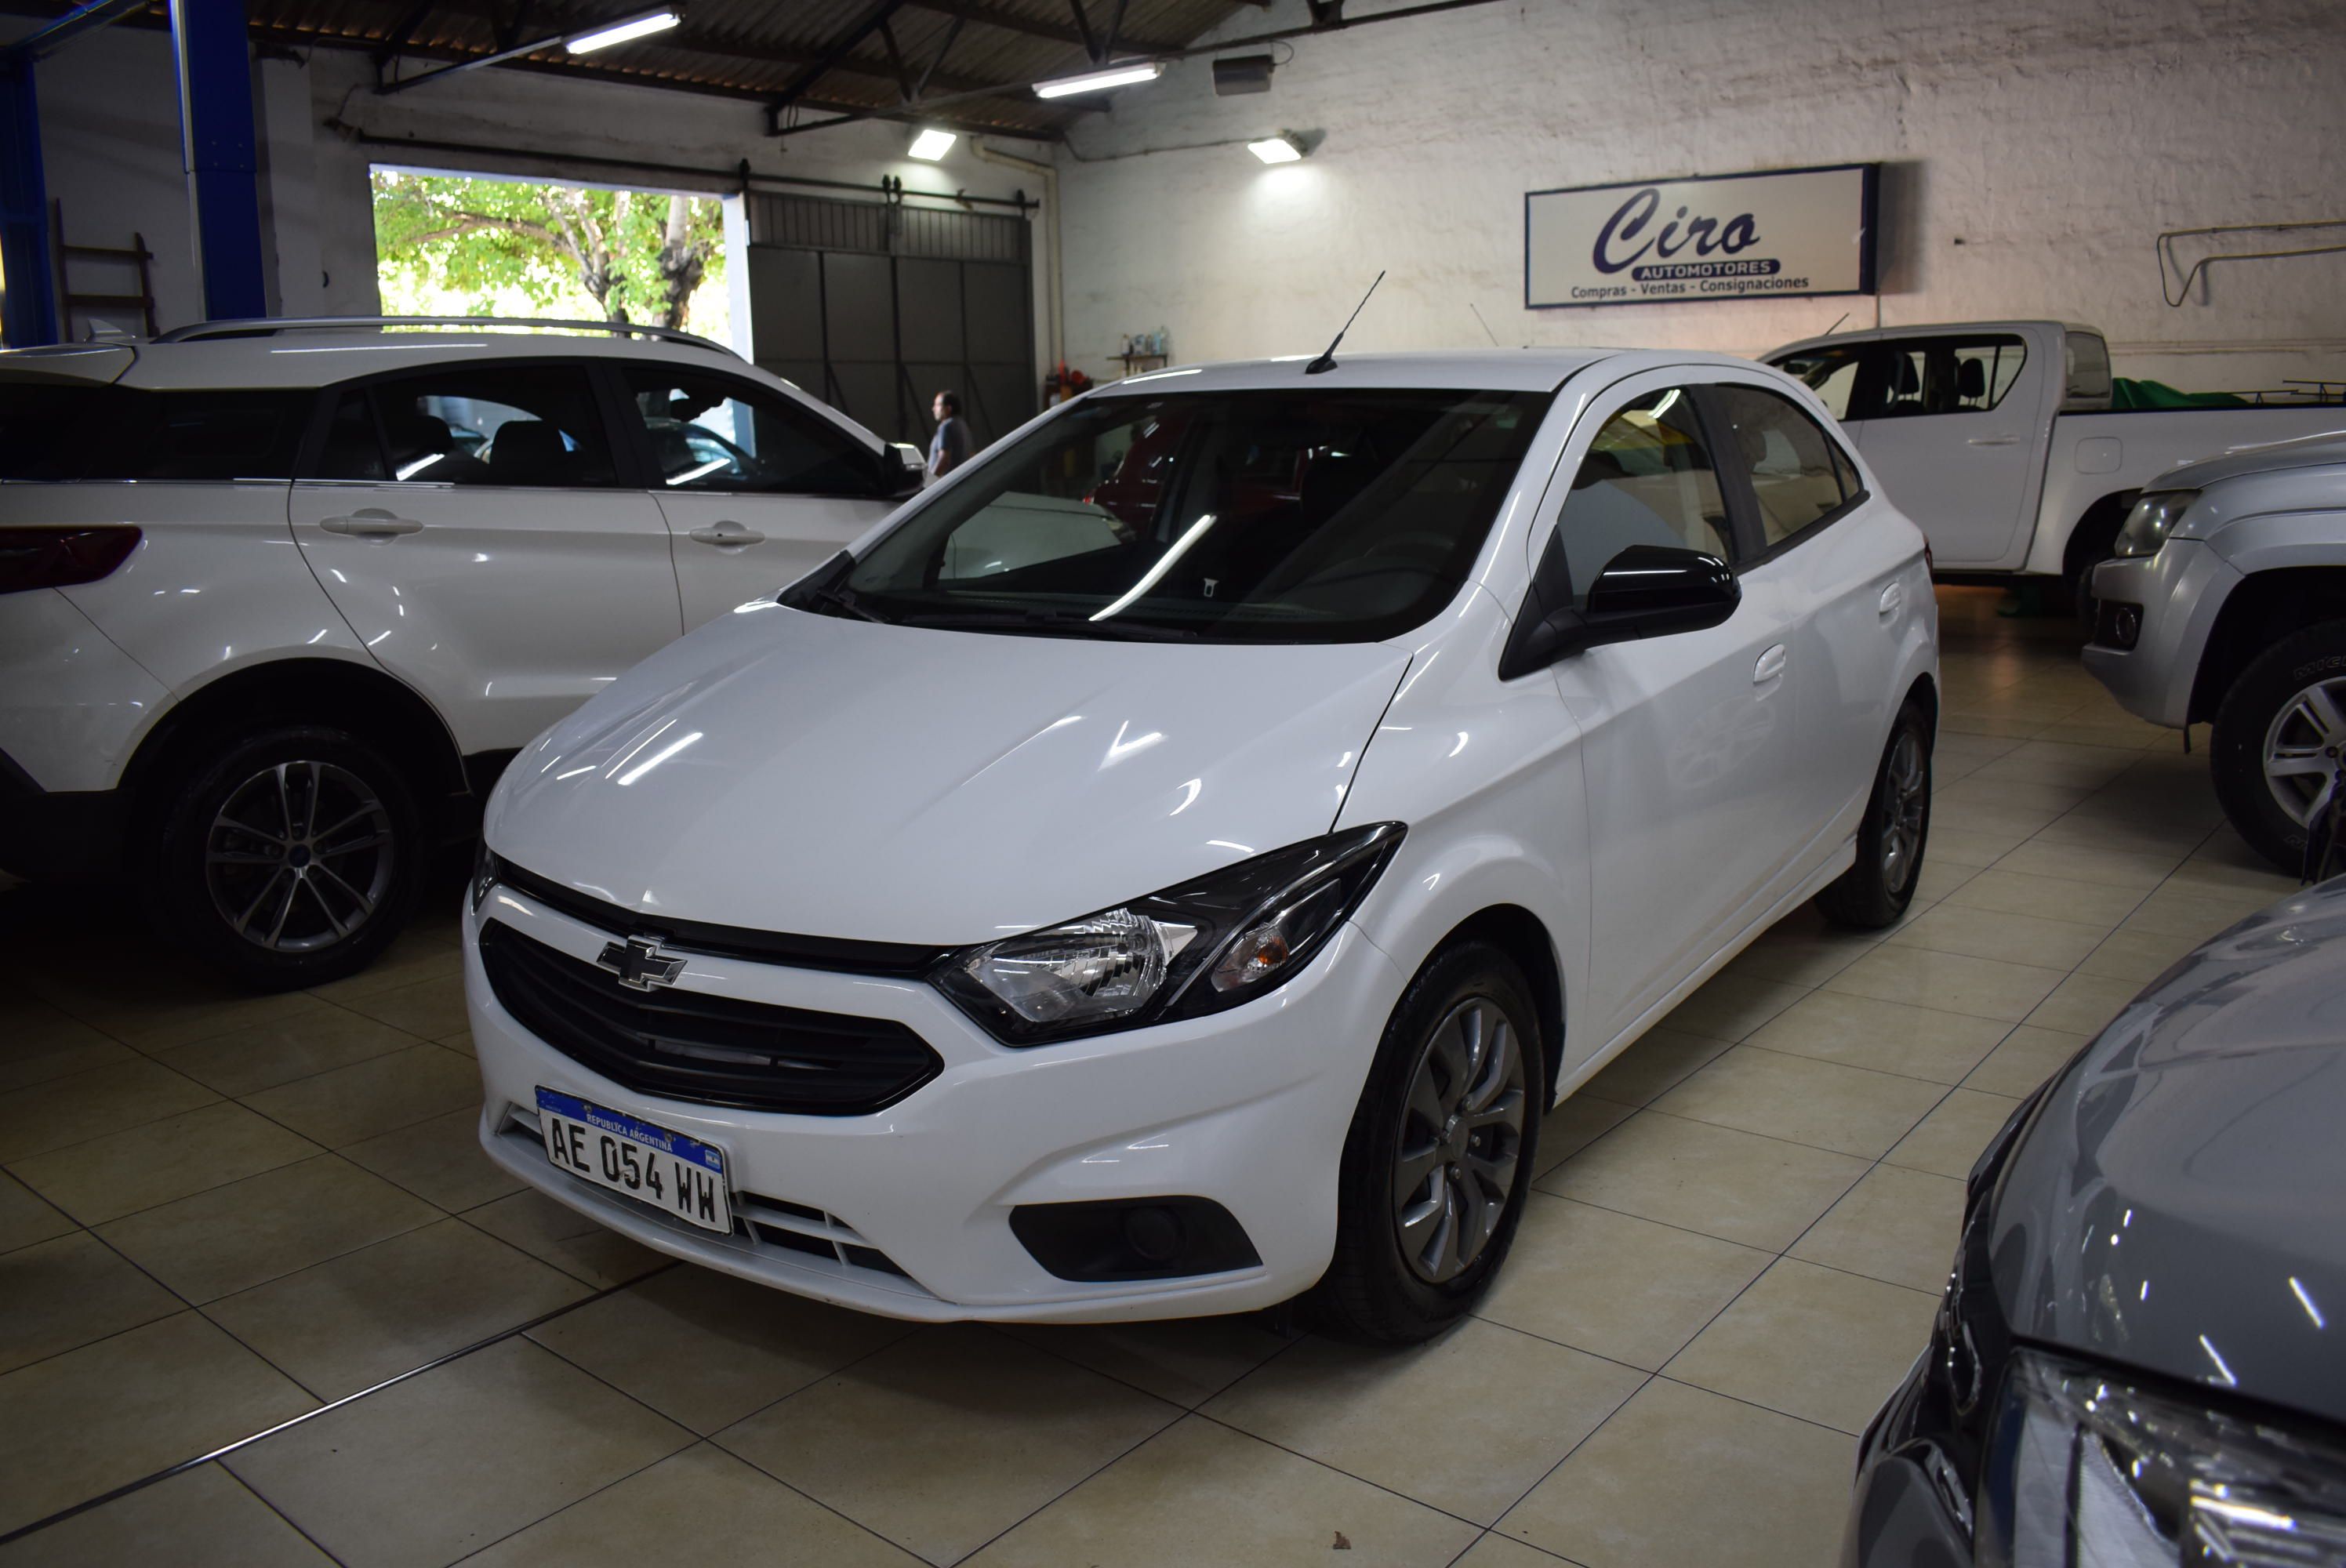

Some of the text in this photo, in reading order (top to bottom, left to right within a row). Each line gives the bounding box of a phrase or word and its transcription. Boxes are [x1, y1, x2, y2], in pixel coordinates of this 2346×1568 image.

[1592, 187, 1760, 274] Ciro
[1640, 261, 1771, 280] AUTOMOTORES
[1571, 284, 1627, 300] Compras
[1641, 281, 1686, 295] Ventas
[1699, 275, 1809, 293] Consignaciones
[629, 1129, 673, 1152] ARGENTINA
[552, 1118, 715, 1223] AE 054 WW
